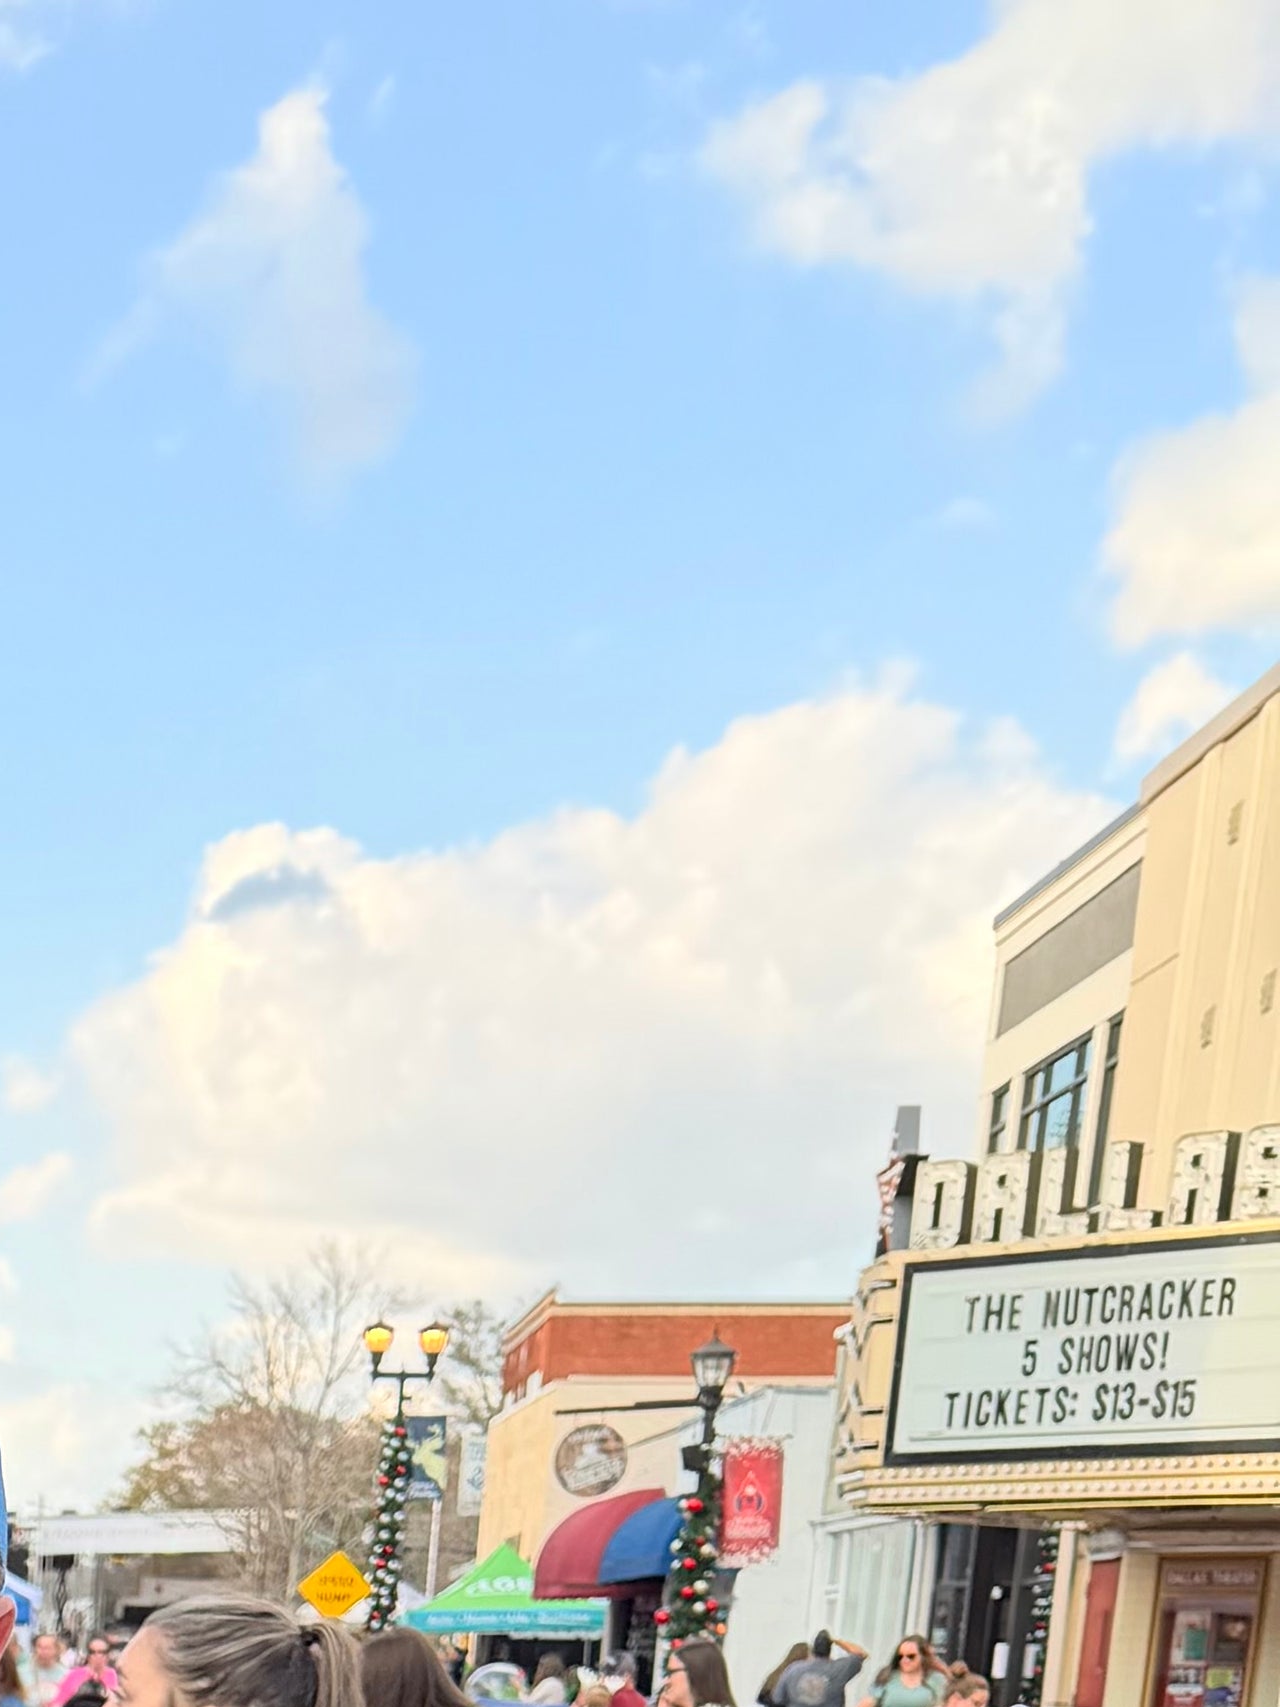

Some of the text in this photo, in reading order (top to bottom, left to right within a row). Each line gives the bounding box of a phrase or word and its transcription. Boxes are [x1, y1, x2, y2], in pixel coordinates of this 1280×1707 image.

[965, 1277, 1238, 1334] THE NUTCRACKER
[1021, 1330, 1171, 1377] 5 SHOWS!
[944, 1385, 1080, 1431] TICKETS:
